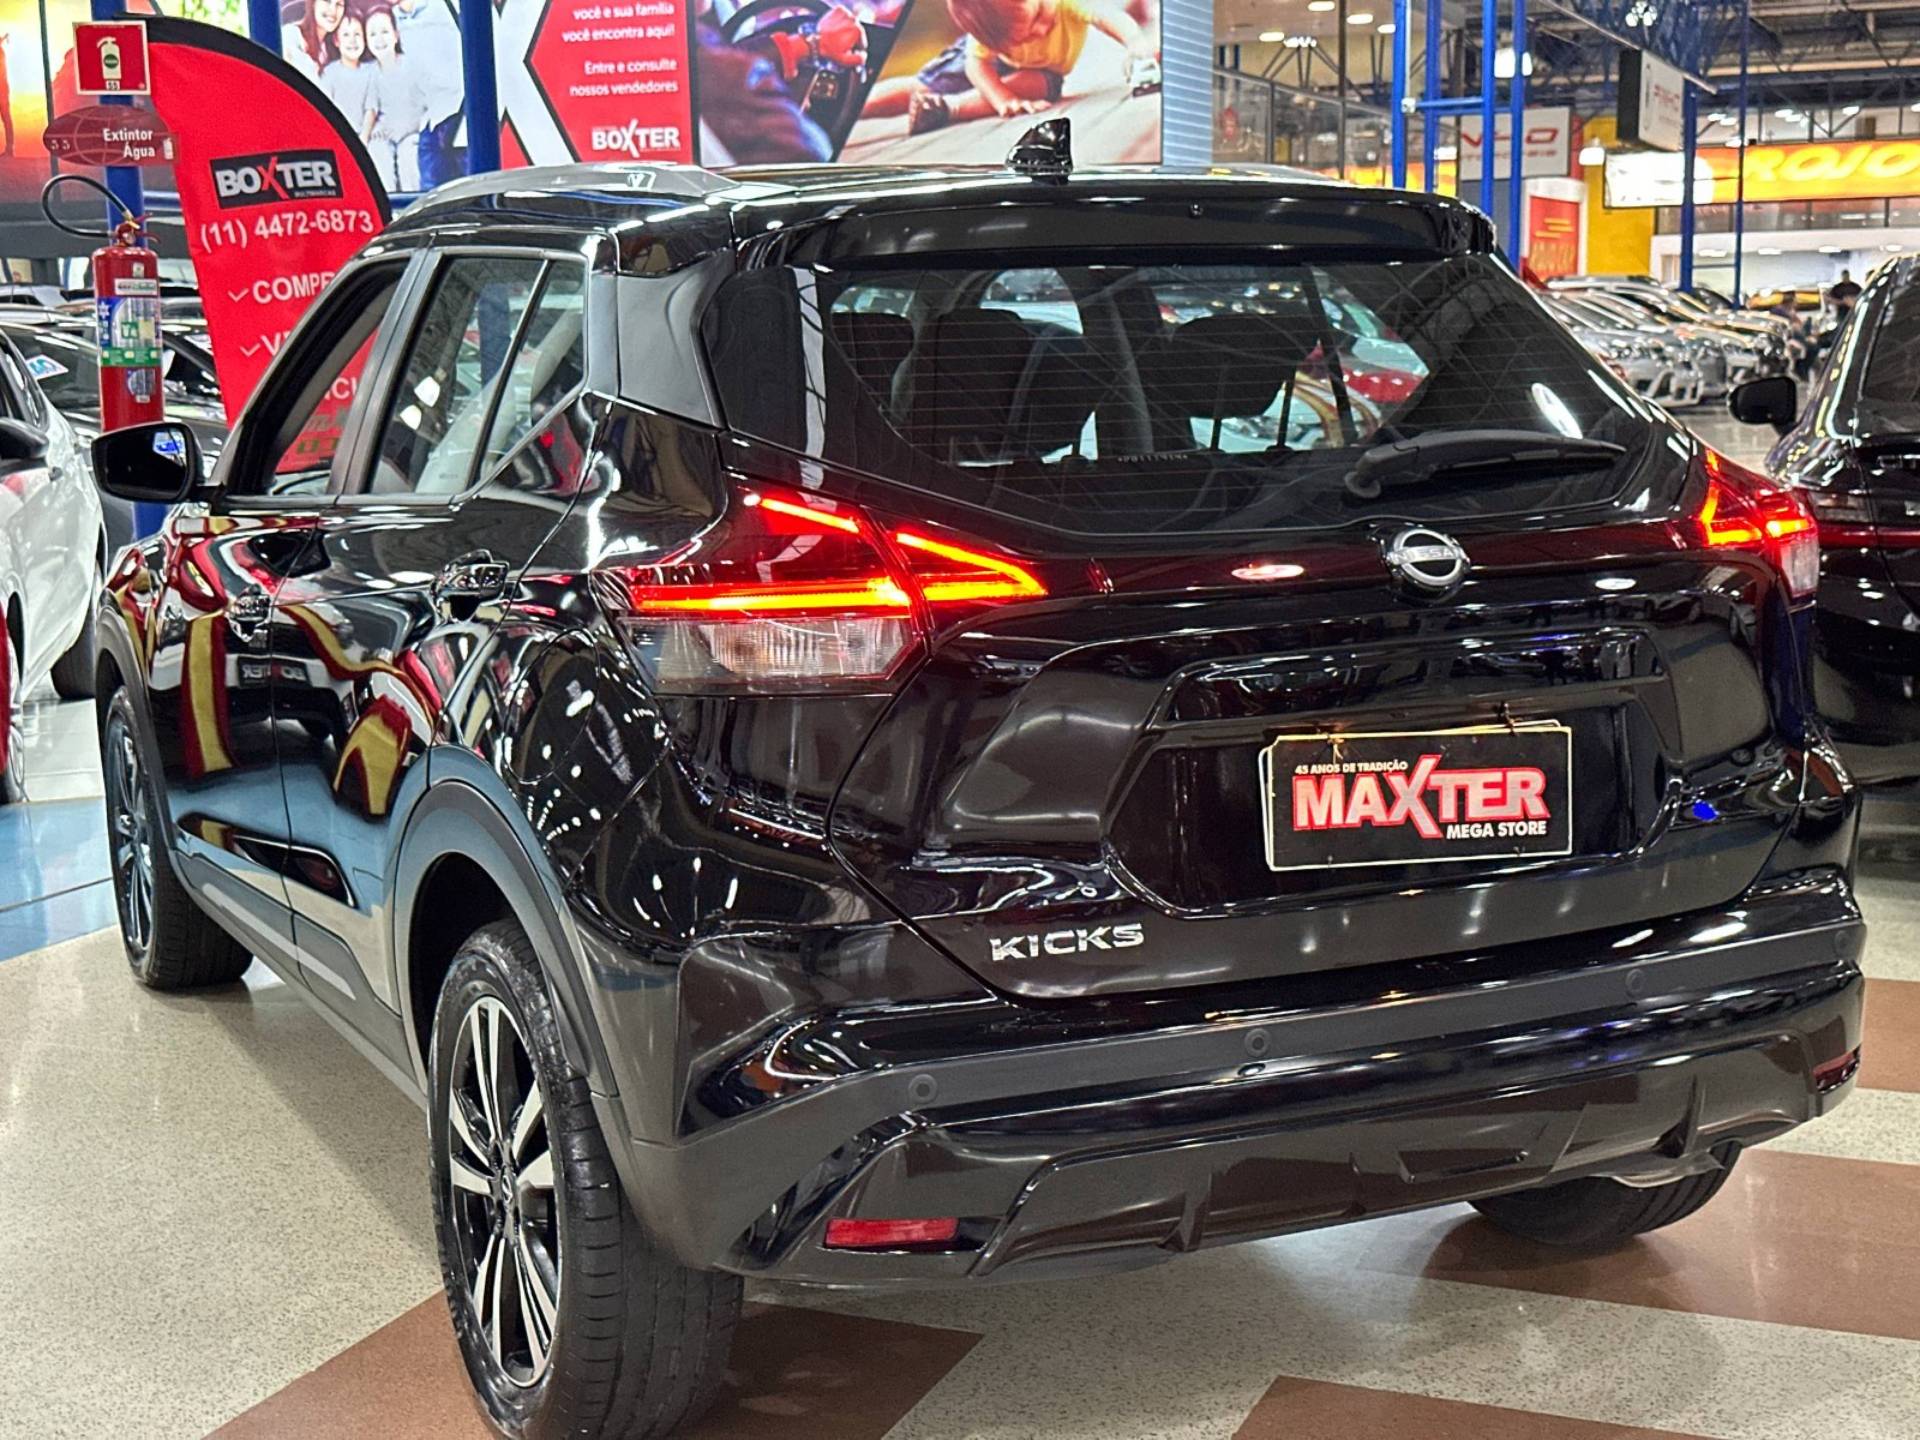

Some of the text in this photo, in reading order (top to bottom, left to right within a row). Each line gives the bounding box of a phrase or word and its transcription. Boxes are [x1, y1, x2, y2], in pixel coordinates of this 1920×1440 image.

[602, 7, 611, 18] e
[612, 7, 634, 18] sua
[561, 28, 590, 42] você
[592, 26, 643, 41] encontra
[584, 58, 677, 75] Entre e consulte
[569, 80, 678, 97] nossos vendedores
[102, 127, 154, 142] Extintor
[592, 118, 681, 158] BOXTER
[123, 141, 156, 160] Água
[214, 156, 337, 201] BOXTER
[200, 209, 374, 254] (11) 4472-6873
[1294, 758, 1409, 775] 45 ANOS DE TRADIÇÃO
[1293, 754, 1551, 839] MAXTER
[1446, 820, 1547, 840] MEGA STORE
[989, 922, 1145, 962] KICKS
